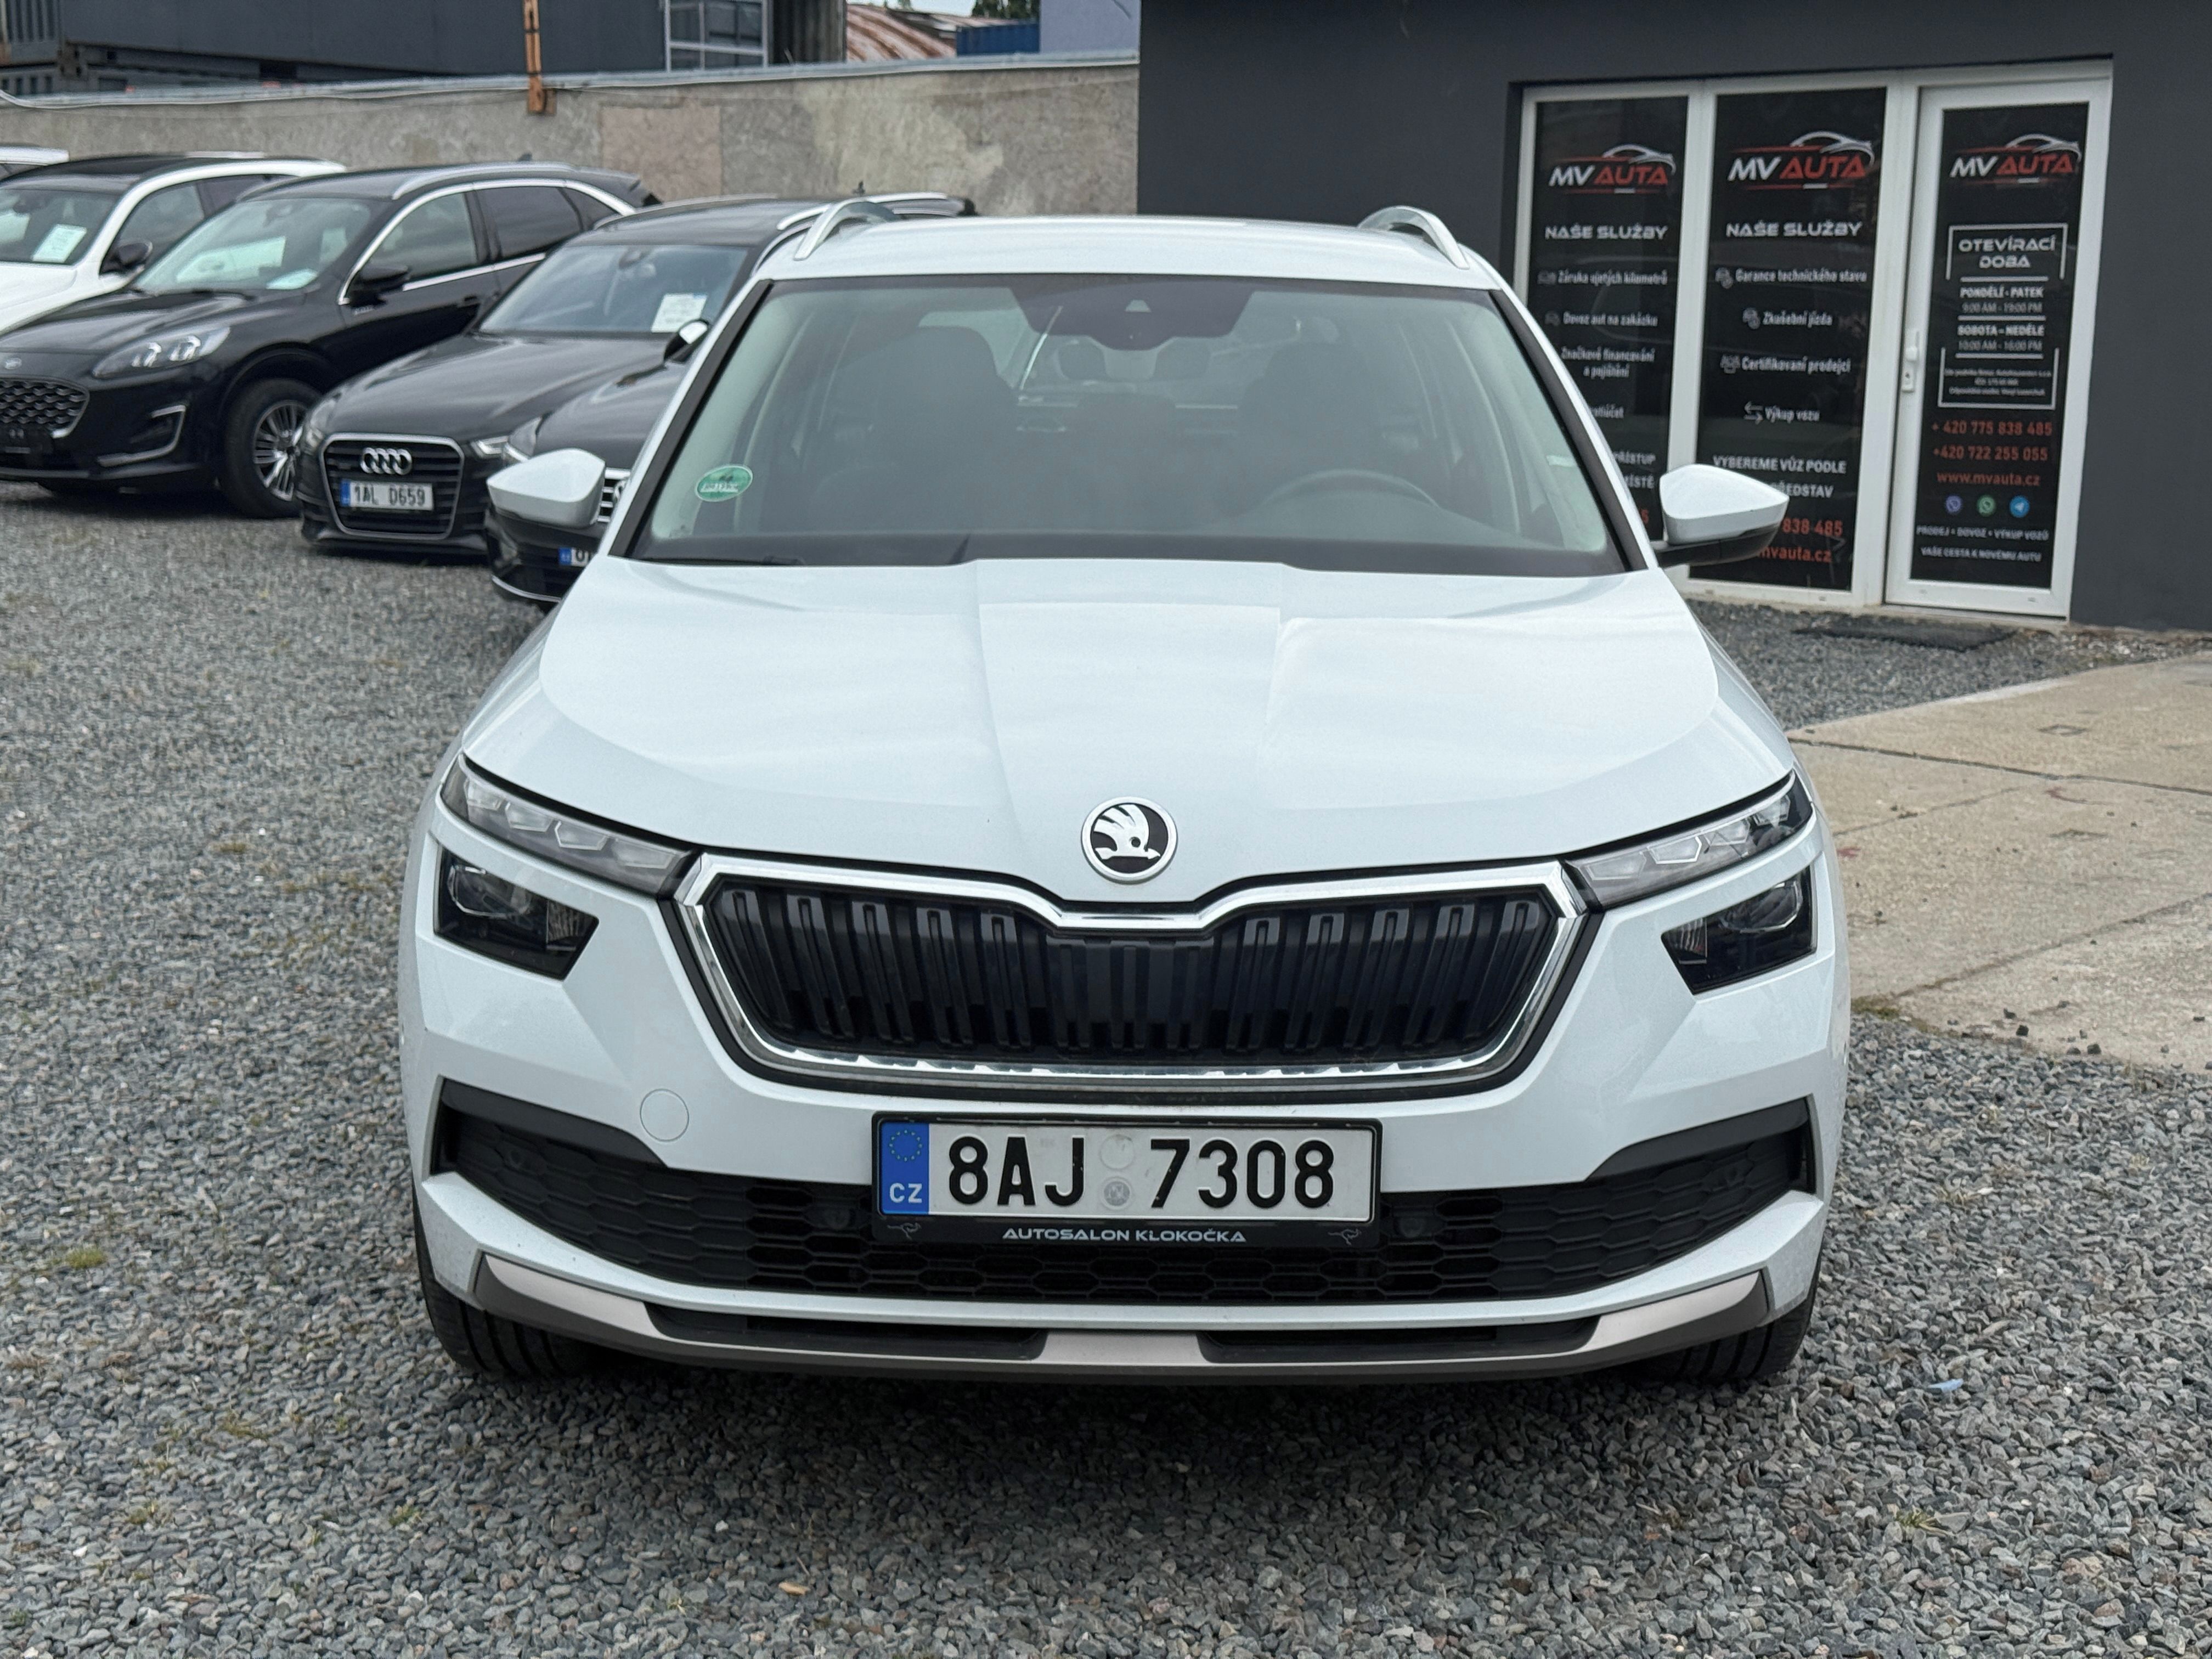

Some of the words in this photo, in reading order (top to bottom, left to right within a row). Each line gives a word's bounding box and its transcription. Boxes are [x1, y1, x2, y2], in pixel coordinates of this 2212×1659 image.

[1728, 156, 1781, 181] MV
[1779, 155, 1866, 179] AUTA
[1950, 156, 1999, 177] MV
[1996, 153, 2073, 175] AUTA
[1549, 165, 1595, 186] MV
[1594, 165, 1668, 185] AUTA
[1544, 222, 1593, 239] NAŠE
[1597, 222, 1668, 240] SLUŽBY
[1726, 220, 1779, 237] NAŠE
[1784, 220, 1862, 237] SLUŽBY
[1958, 234, 2057, 252] OTEVÍRACÍ
[1979, 255, 2031, 268] DOBA
[1943, 420, 1967, 434] 420
[1713, 455, 1778, 471] VYBEREME
[1779, 455, 1804, 472] VŮZ
[1806, 459, 1847, 474] PODLE
[1782, 518, 1810, 535] 838
[1814, 520, 1843, 537] 485
[949, 1136, 1084, 1206] 8AJ
[1150, 1138, 1335, 1209] 7308
[890, 1182, 923, 1204] CZ
[1002, 1228, 1129, 1242] AUTOSALON
[1135, 1228, 1246, 1243] KLOKOČKA
